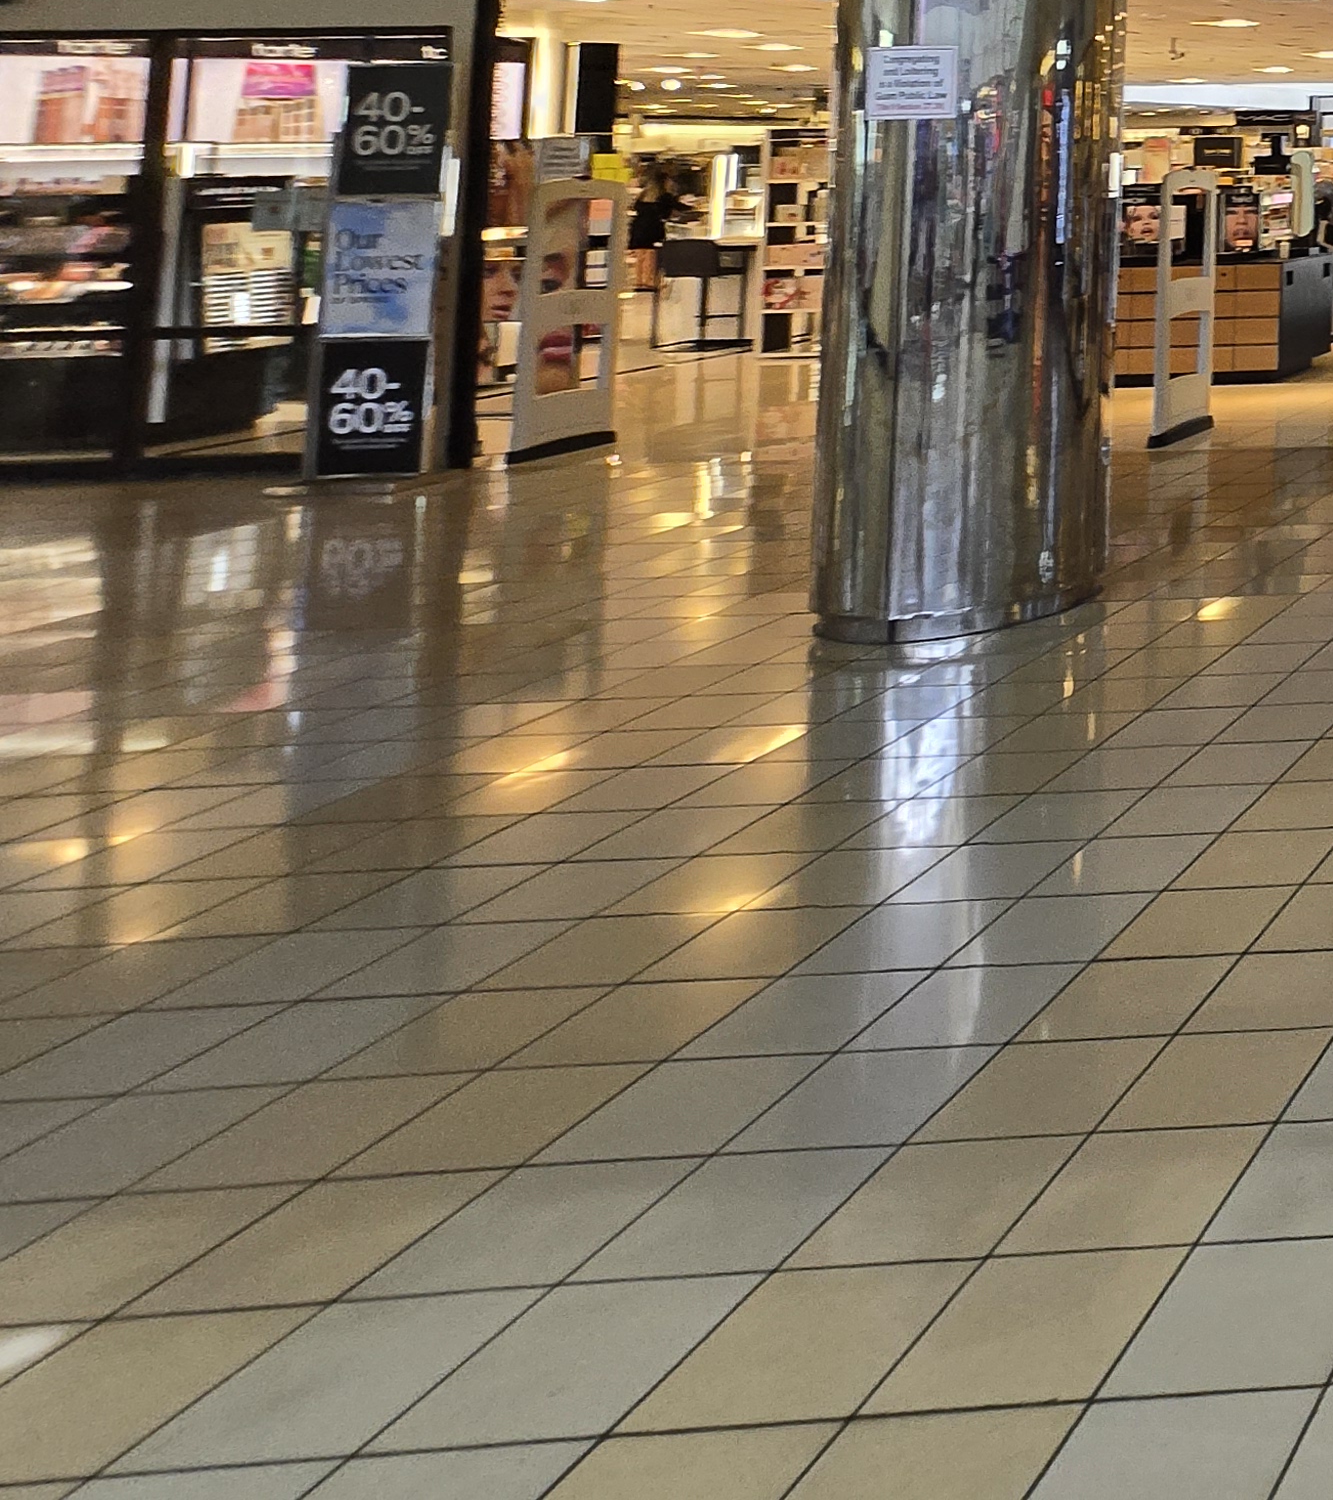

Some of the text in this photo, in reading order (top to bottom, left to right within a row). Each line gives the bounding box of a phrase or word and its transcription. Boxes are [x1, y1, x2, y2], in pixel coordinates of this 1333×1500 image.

[353, 91, 425, 122] 40-
[352, 124, 437, 156] 60%
[330, 367, 401, 400] 40-
[328, 400, 414, 435] 60%
